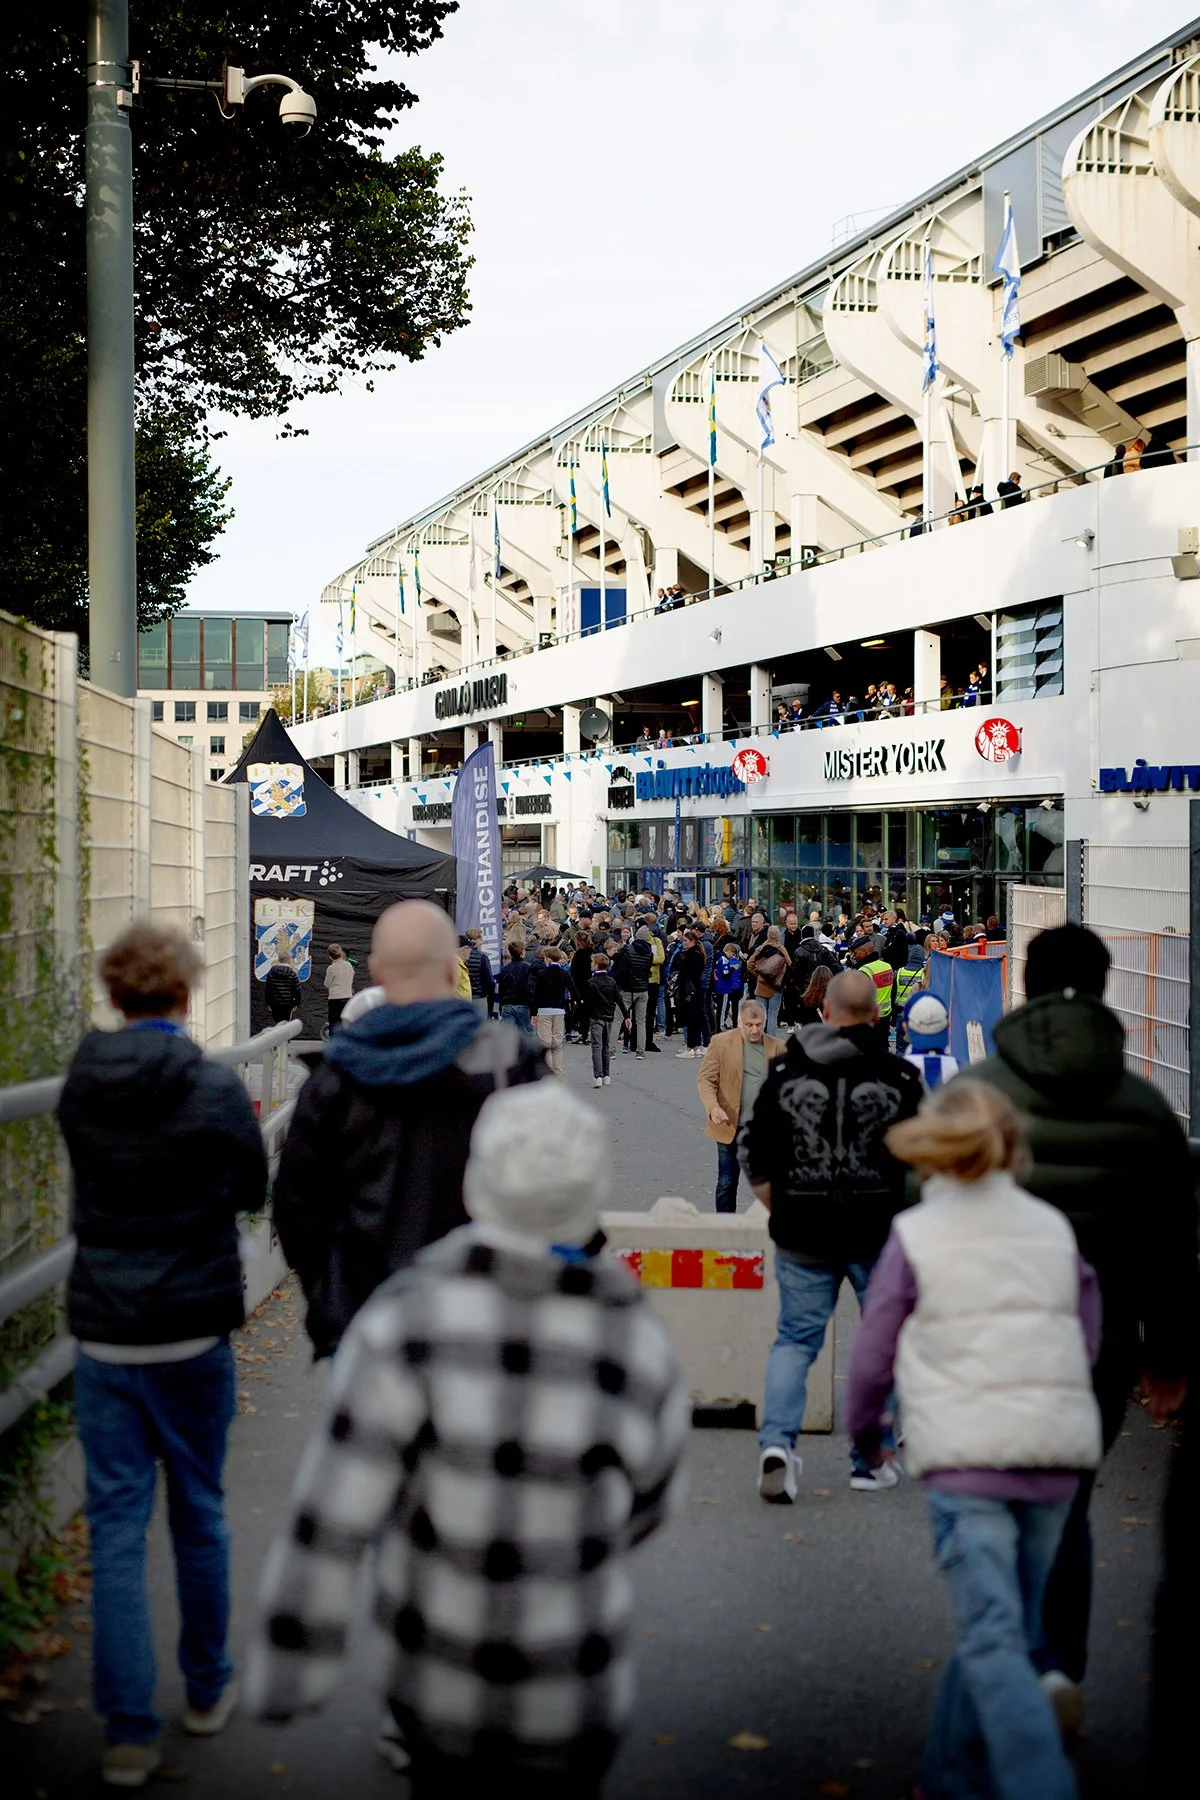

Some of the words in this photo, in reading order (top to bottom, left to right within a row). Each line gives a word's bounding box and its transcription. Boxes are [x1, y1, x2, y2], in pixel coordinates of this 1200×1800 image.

[803, 548, 815, 564] D
[823, 746, 888, 779] MISTER
[890, 738, 947, 775] YORK
[473, 766, 501, 969] MERCHANDISE
